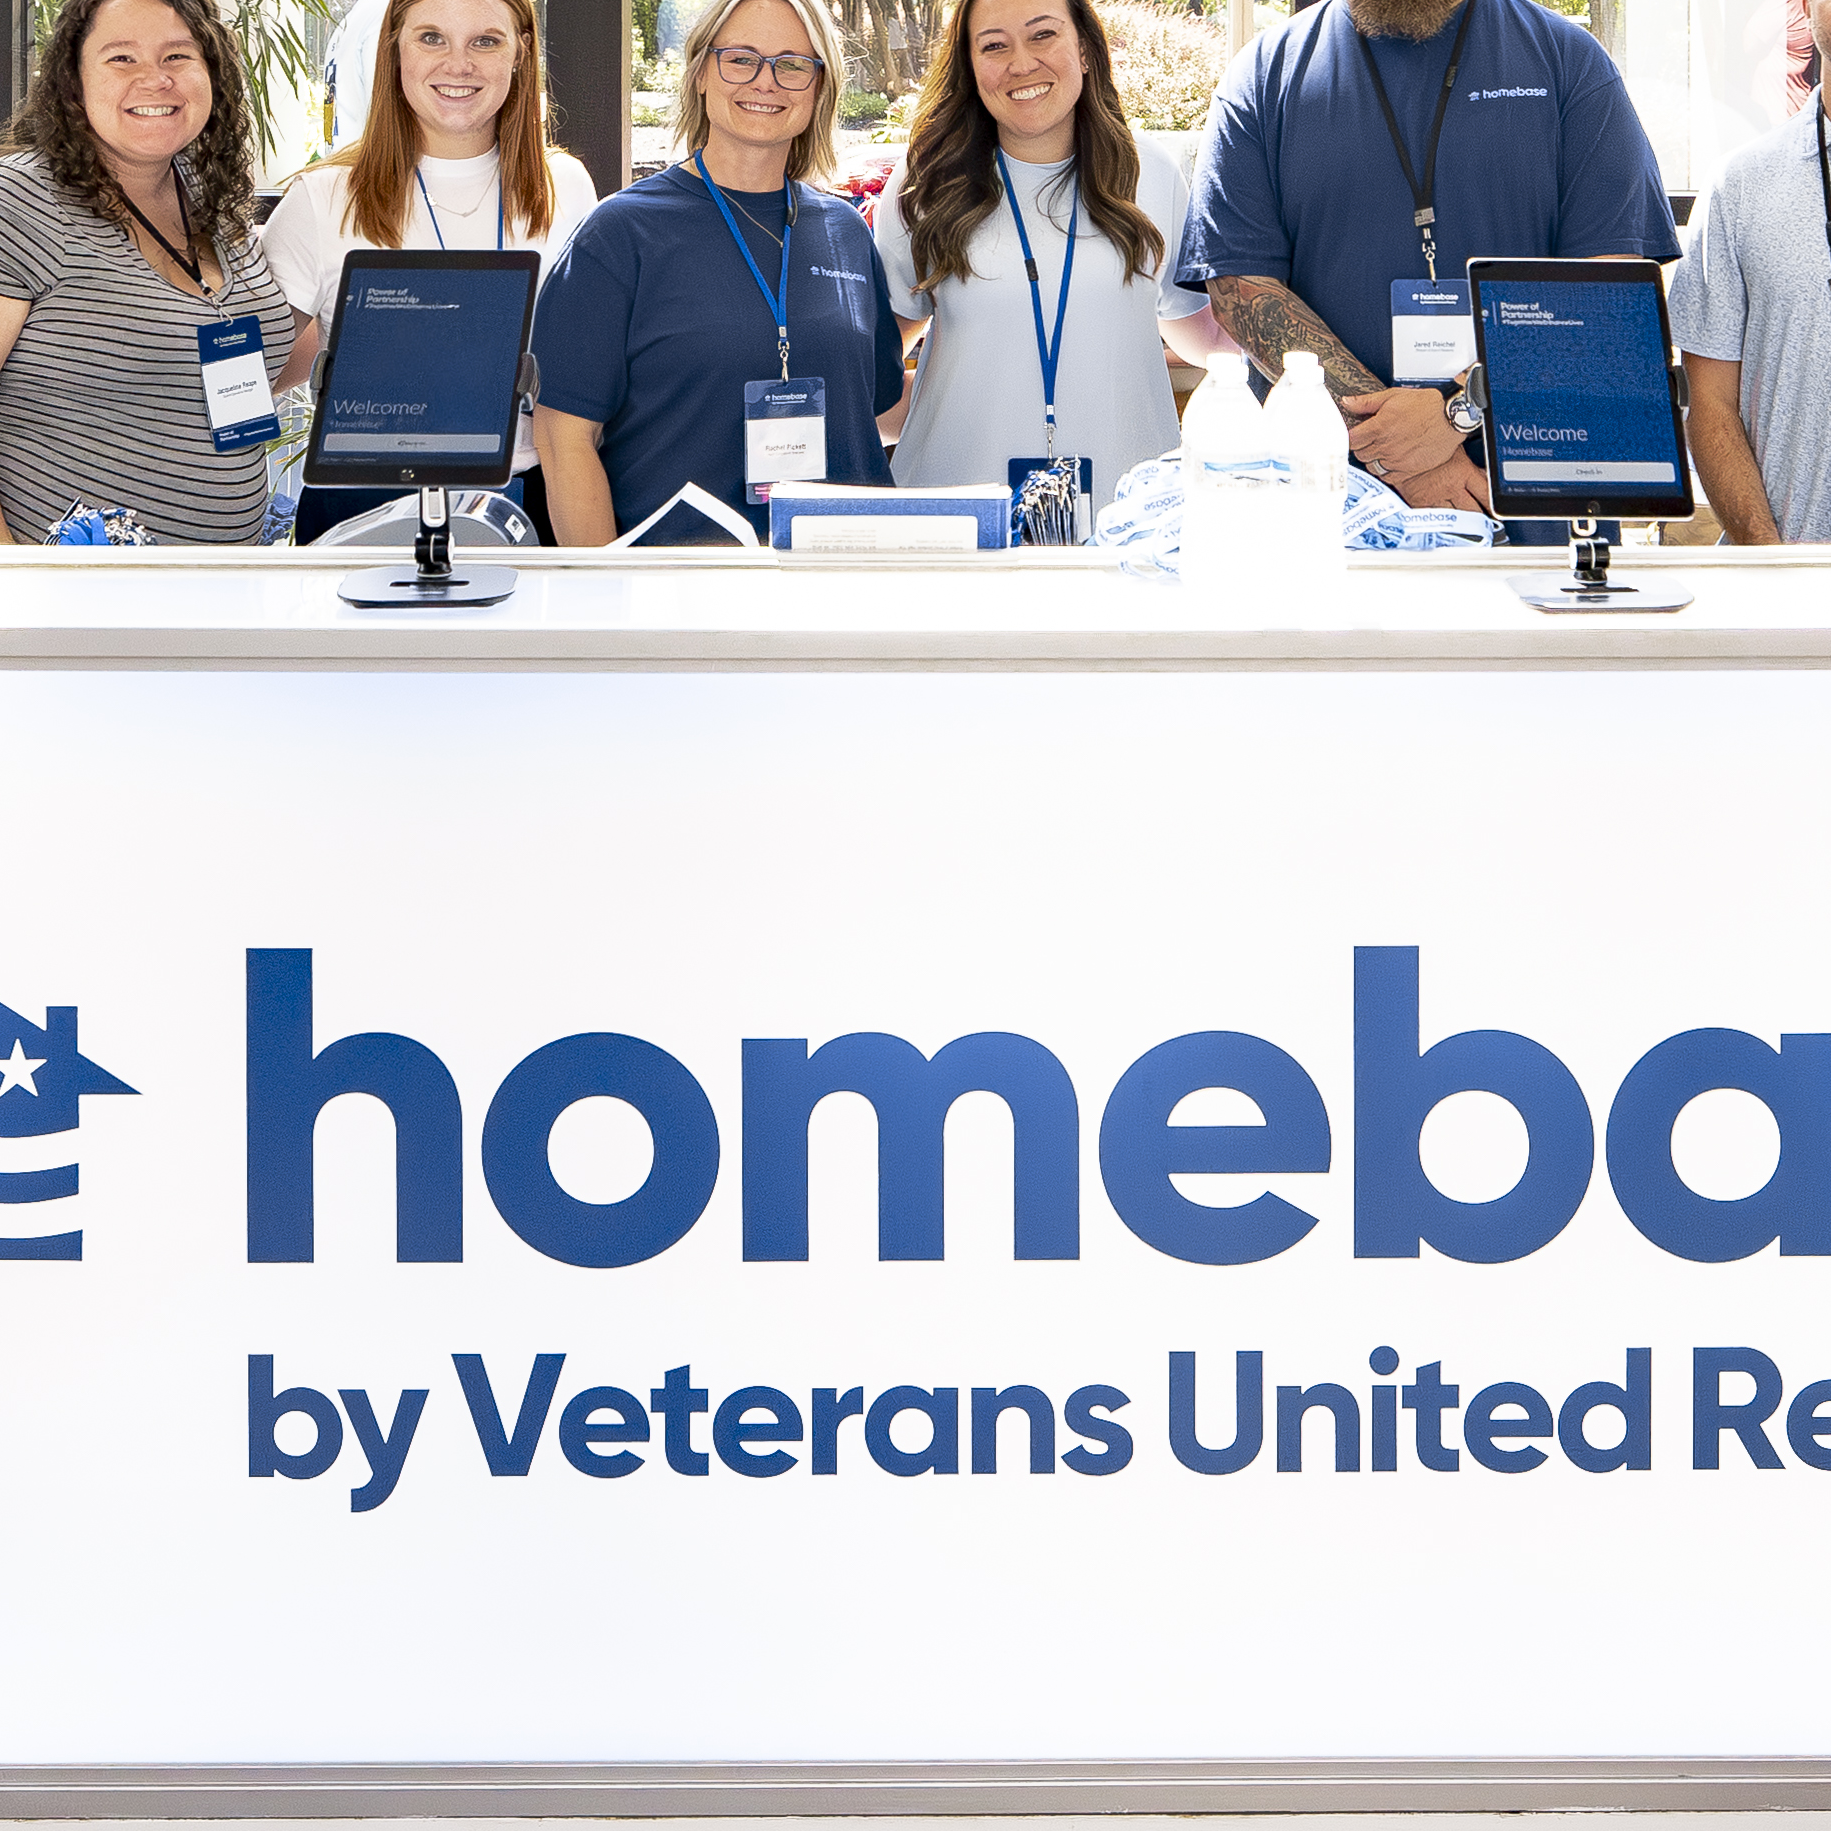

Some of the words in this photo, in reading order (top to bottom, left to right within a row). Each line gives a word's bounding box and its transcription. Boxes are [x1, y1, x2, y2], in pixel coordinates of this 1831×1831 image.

[1483, 86, 1548, 99] homebase
[820, 266, 867, 282] homebase
[366, 294, 420, 304] Partnership
[1420, 293, 1459, 301] homebase
[1500, 301, 1528, 310] Power
[1530, 301, 1539, 310] of
[1501, 310, 1554, 320] Partnership
[772, 393, 807, 401] homebase
[1500, 424, 1588, 442] Welcome
[249, 1355, 428, 1511] by
[452, 1353, 1133, 1477] Veterans
[1169, 1346, 1651, 1474] United
